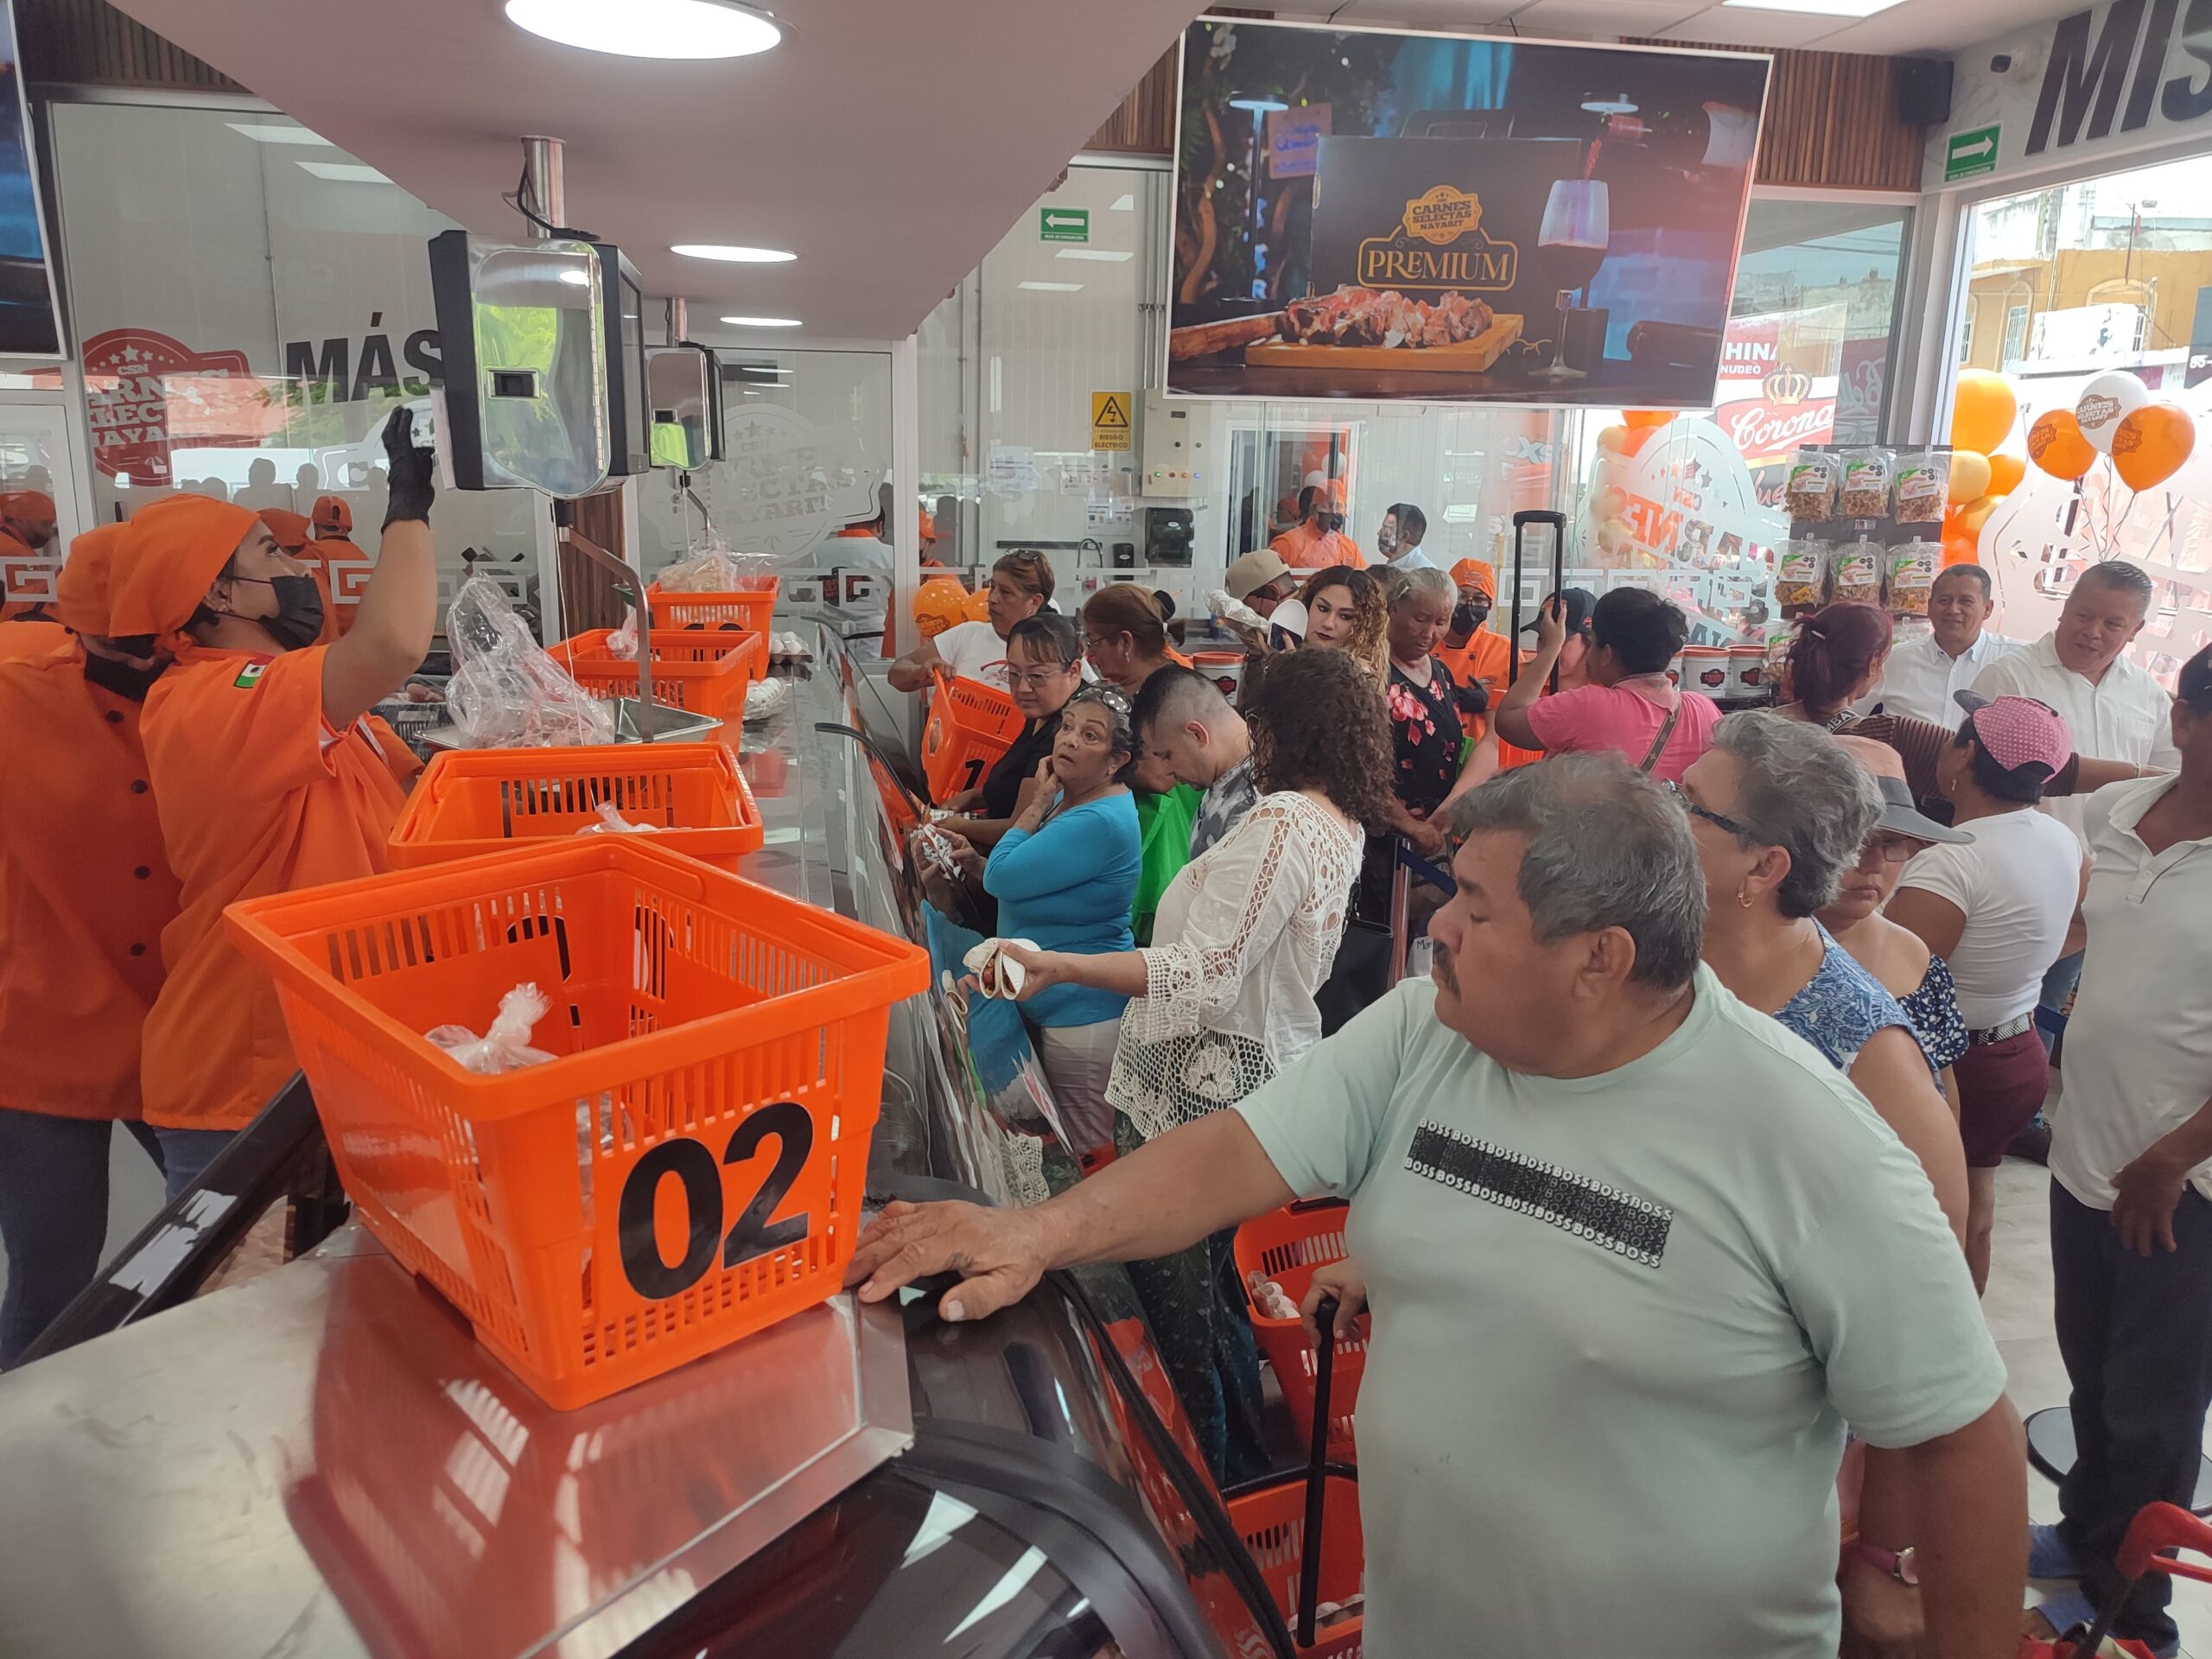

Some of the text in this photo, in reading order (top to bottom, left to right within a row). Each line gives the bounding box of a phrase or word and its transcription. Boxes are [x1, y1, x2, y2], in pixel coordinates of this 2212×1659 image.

[1413, 200, 1471, 215] CARNES
[1413, 210, 1471, 224] SELECTAS
[1367, 250, 1510, 281] PREMIUM
[117, 363, 149, 375] CSN
[286, 311, 444, 405] MÁS
[1731, 403, 1834, 452] Corona
[619, 1102, 814, 1300] 02
